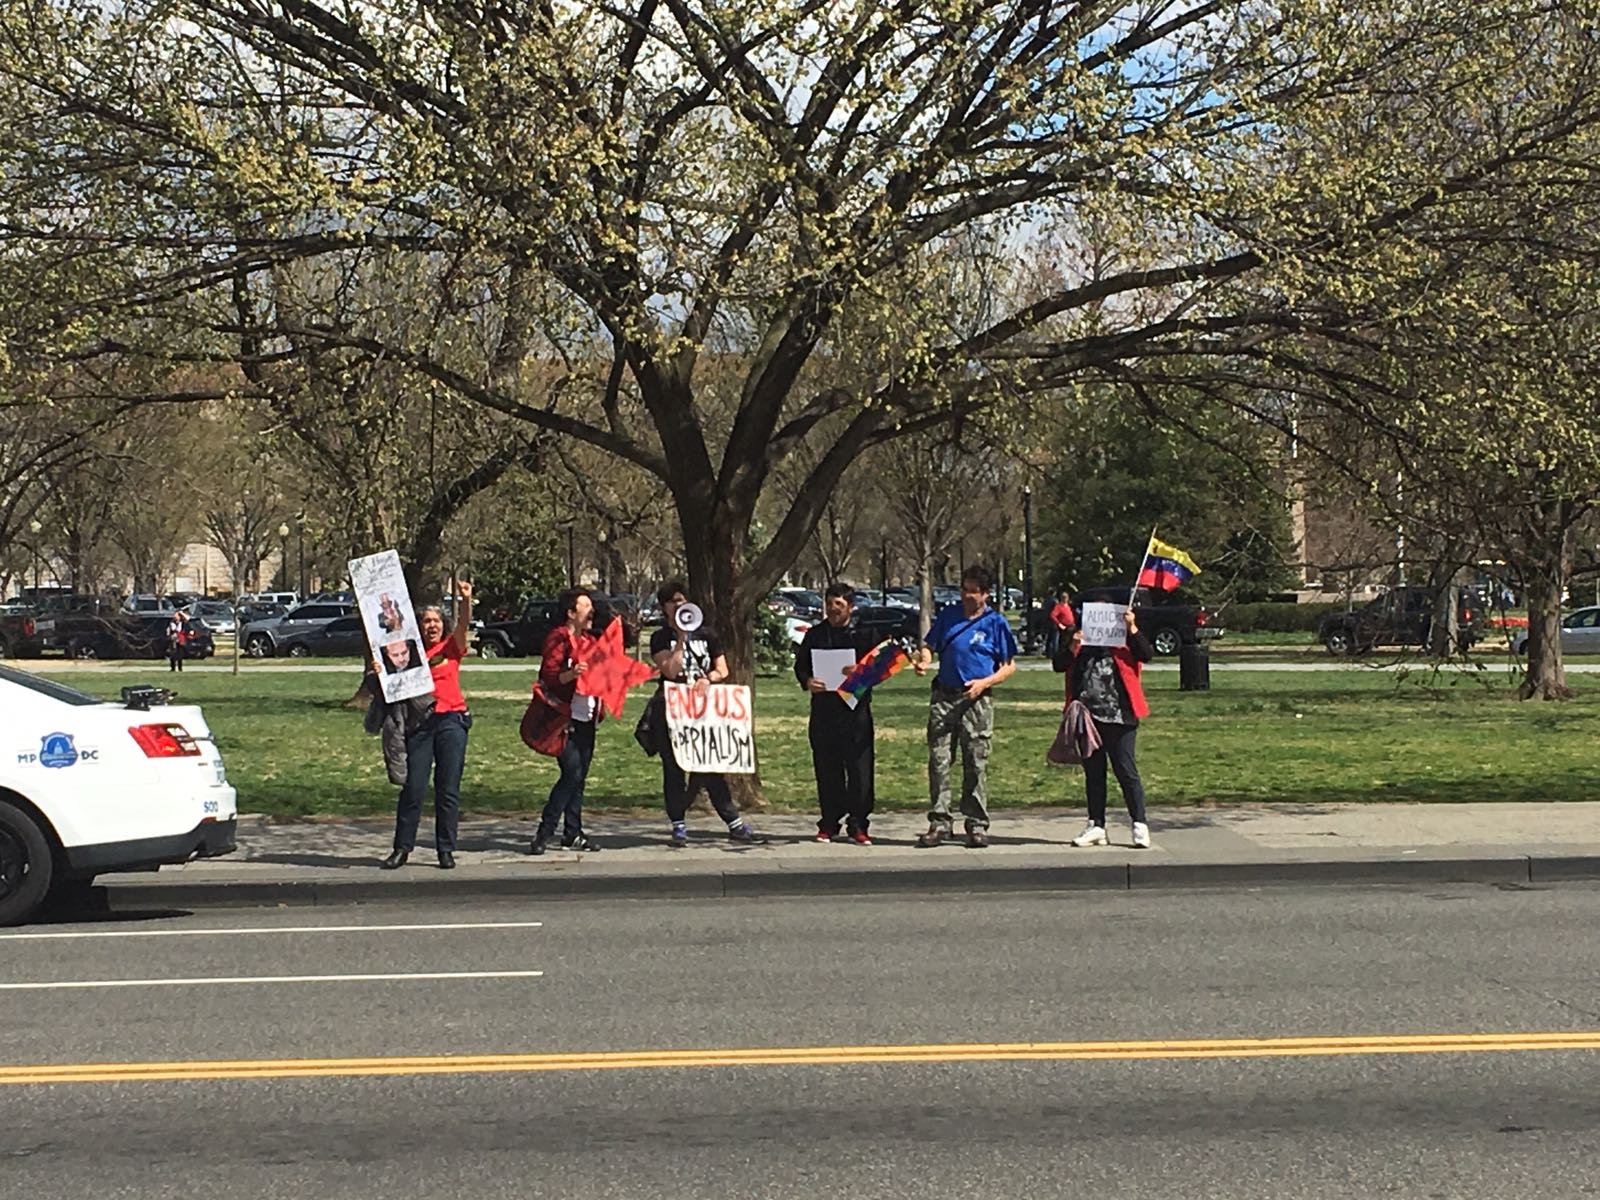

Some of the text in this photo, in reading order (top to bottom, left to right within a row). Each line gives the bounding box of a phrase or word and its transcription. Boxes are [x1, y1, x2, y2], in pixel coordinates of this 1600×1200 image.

[667, 686, 708, 720] END
[17, 753, 37, 764] MP
[668, 724, 752, 768] PERIALISM
